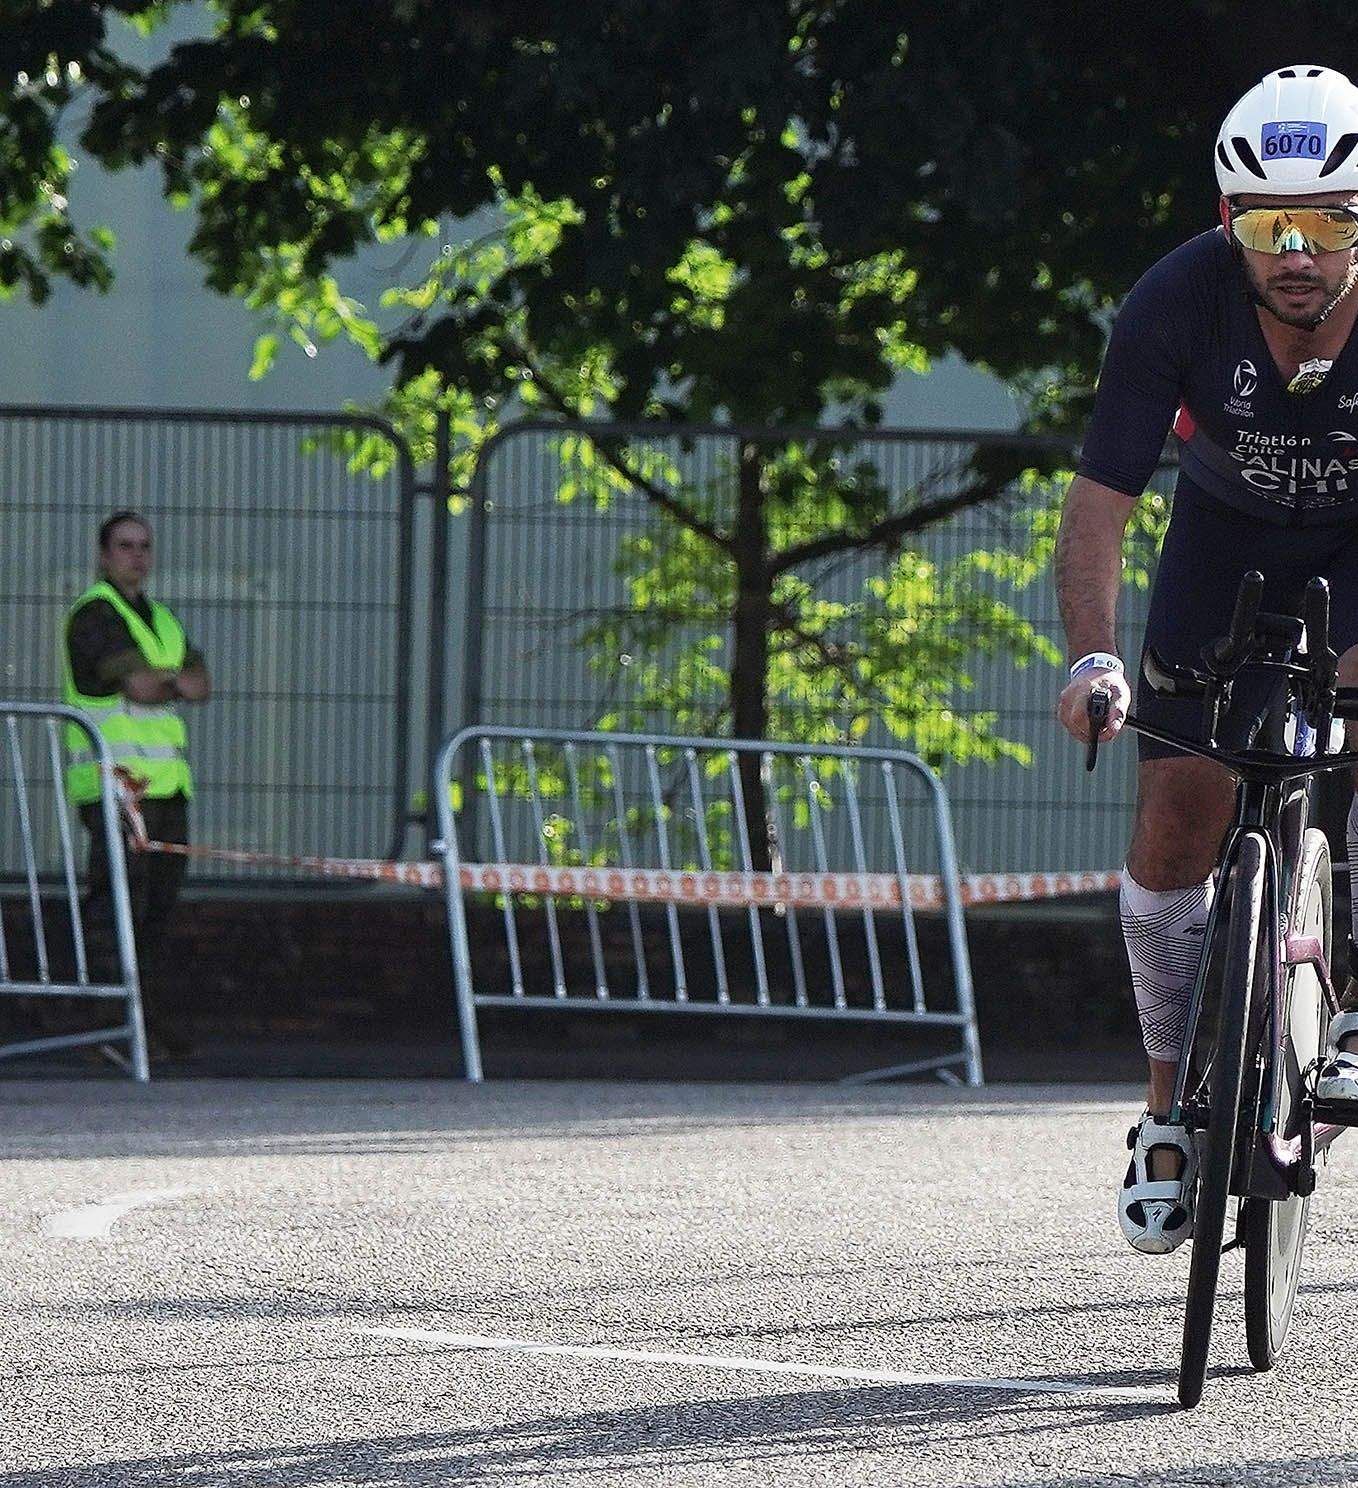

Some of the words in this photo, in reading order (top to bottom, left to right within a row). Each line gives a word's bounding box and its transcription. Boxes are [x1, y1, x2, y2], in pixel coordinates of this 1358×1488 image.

[1265, 134, 1321, 155] 6070
[1237, 430, 1311, 446] Triatlón
[1235, 444, 1286, 455] Chile
